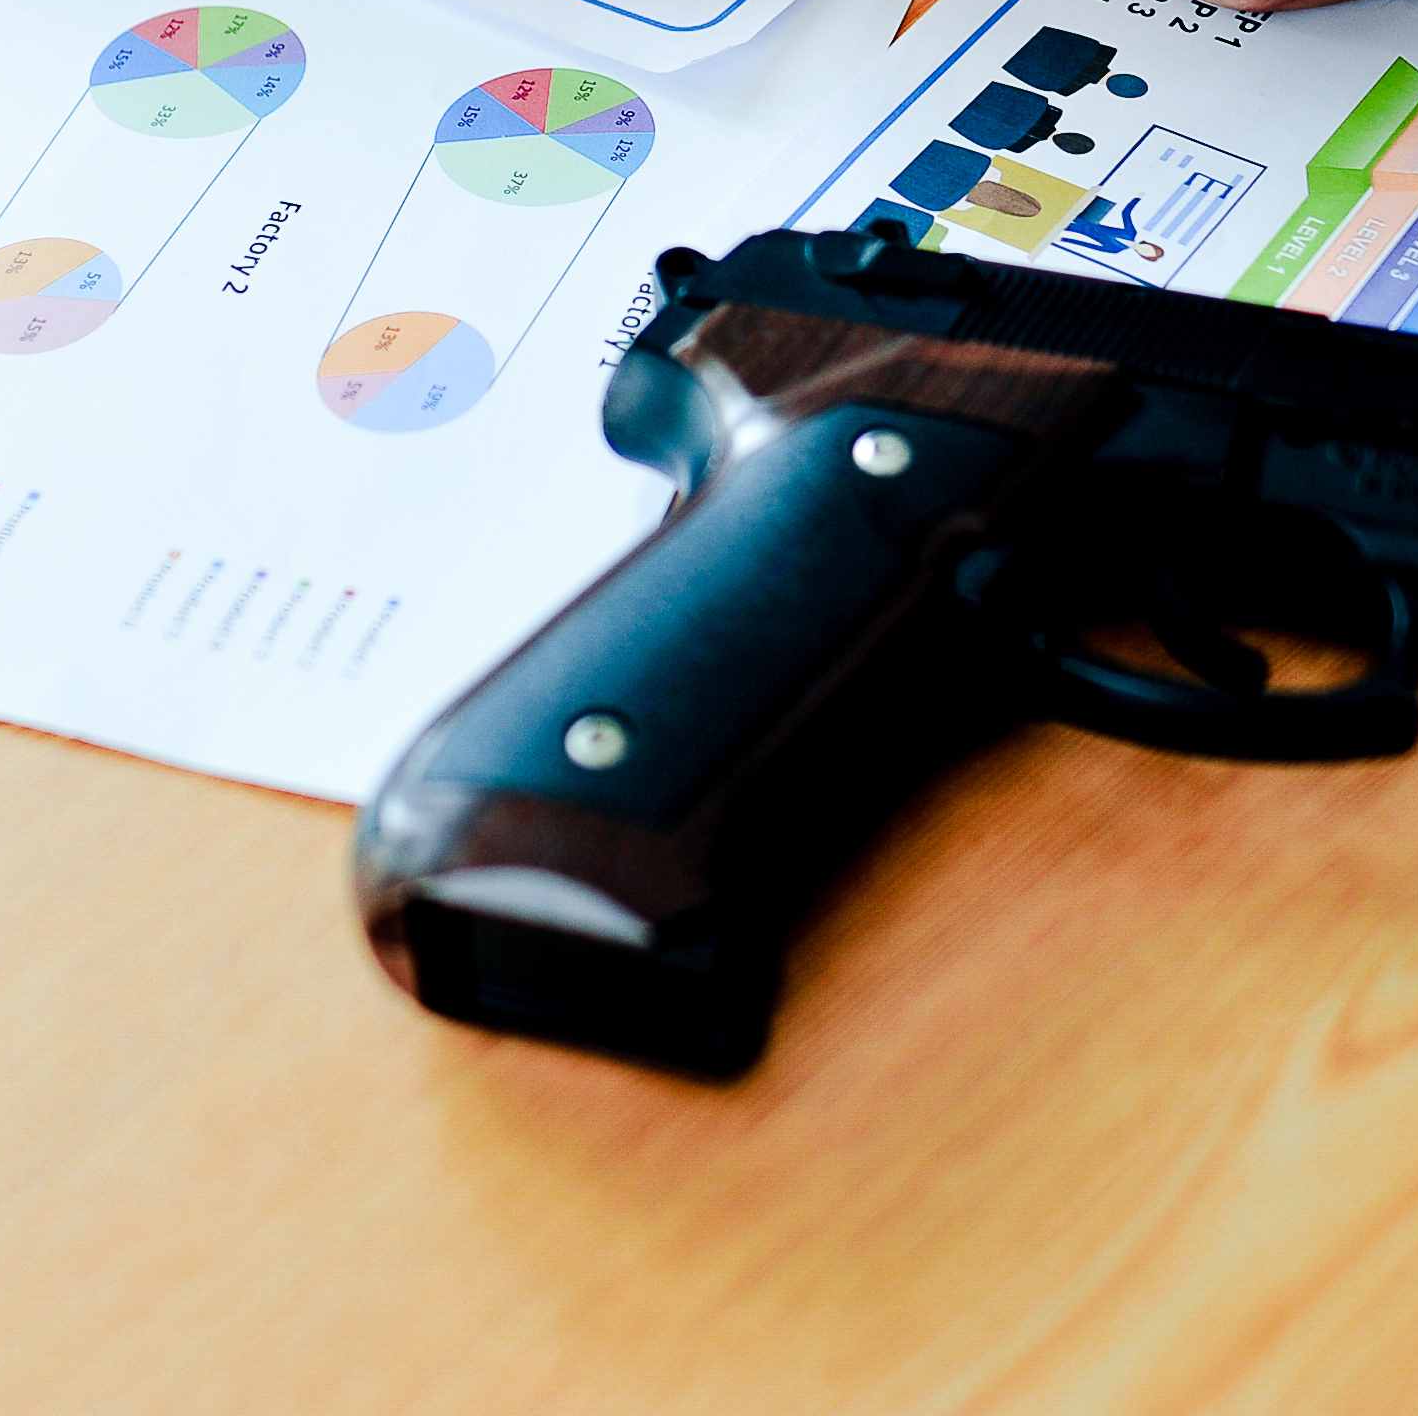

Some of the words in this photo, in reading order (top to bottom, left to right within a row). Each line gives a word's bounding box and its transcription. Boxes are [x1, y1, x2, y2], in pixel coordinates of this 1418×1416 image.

[1128, 2, 1156, 17] 3
[1168, 16, 1200, 33] 2
[109, 48, 133, 70] 15%
[265, 43, 285, 58] 9%
[256, 75, 280, 98] 14%
[512, 79, 535, 101] 12%
[574, 79, 597, 101] 15%
[150, 105, 177, 127] 33%
[457, 105, 481, 128] 15%
[616, 110, 635, 126] 9%
[610, 139, 633, 162] 12%
[504, 171, 528, 195] 37%
[230, 201, 301, 276] Factory
[1275, 215, 1326, 260] LEVEL
[1336, 218, 1388, 265] LEVEL
[5, 251, 32, 274] 13%
[1267, 265, 1285, 274] 1
[1326, 266, 1347, 277] 2
[79, 272, 102, 290] 5%
[1390, 269, 1410, 281] 3
[222, 281, 249, 293] 2
[604, 271, 654, 351] actory
[374, 326, 400, 351] 13%
